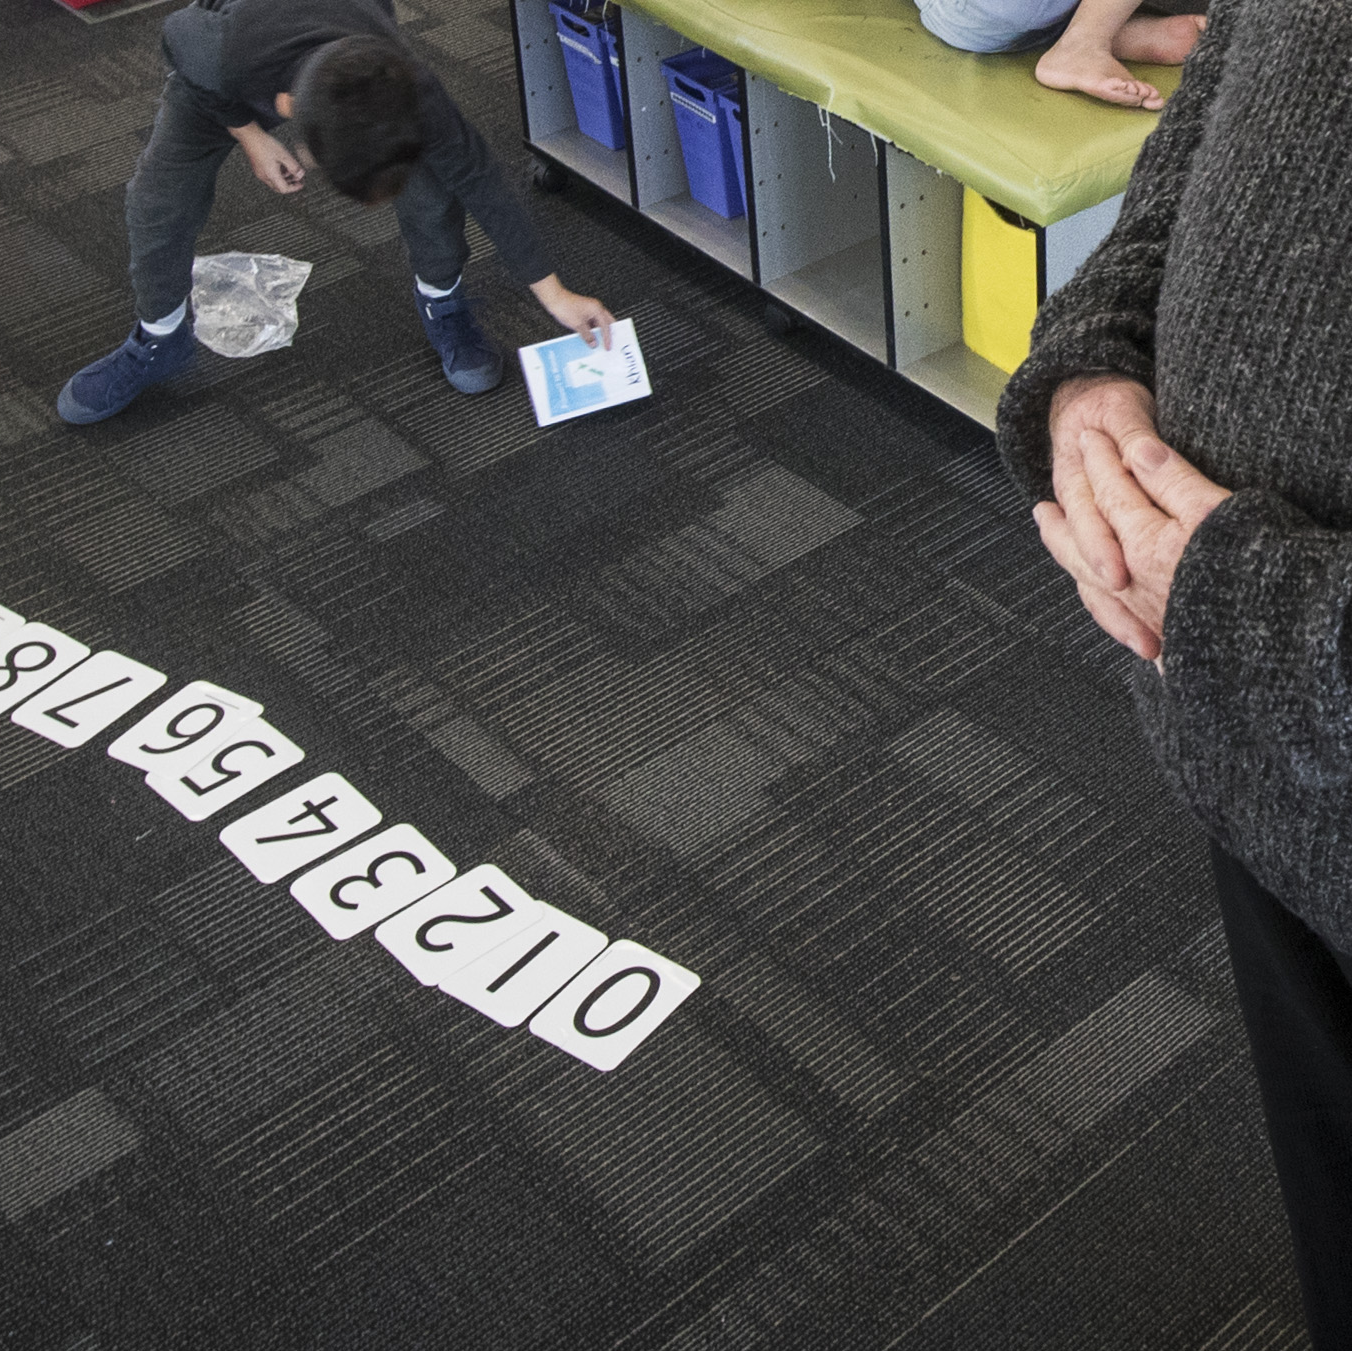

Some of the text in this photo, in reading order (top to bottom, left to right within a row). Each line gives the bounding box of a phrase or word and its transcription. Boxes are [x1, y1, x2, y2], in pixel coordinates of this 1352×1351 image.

[44, 677, 131, 728] 7
[140, 704, 224, 754] 6
[181, 741, 275, 796] 5
[256, 796, 338, 843] 4
[330, 851, 425, 909] 3
[416, 886, 514, 952] 2
[487, 932, 559, 992] 1
[574, 967, 660, 1037] 0
